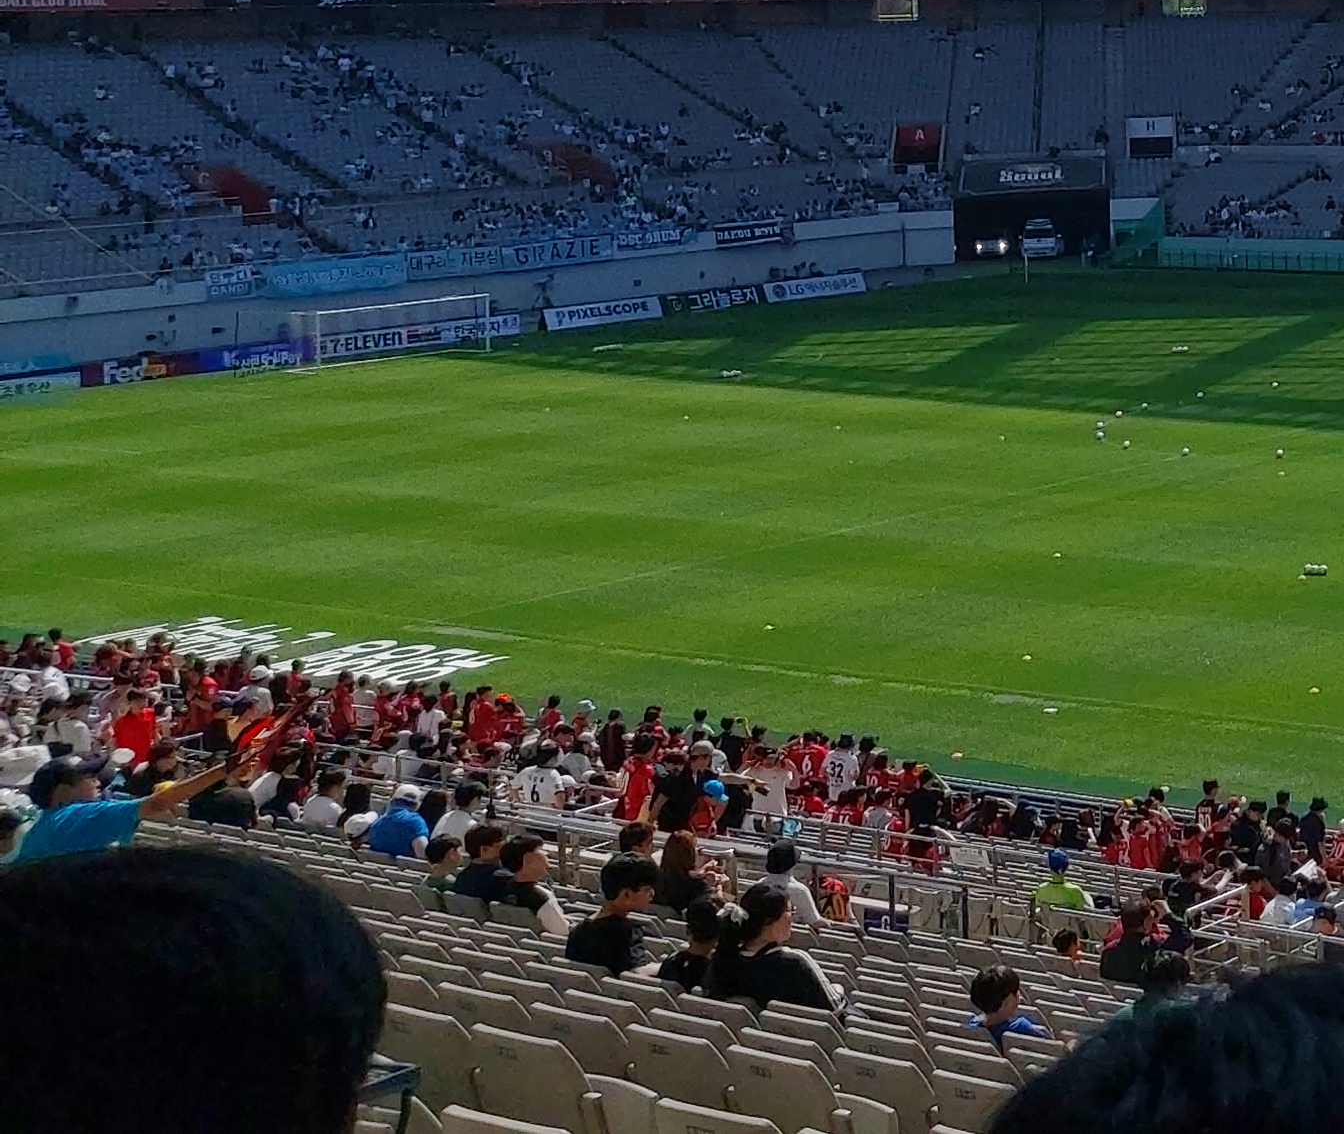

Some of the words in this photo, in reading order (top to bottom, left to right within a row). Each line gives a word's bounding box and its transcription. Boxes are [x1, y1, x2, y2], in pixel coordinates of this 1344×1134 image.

[1146, 120, 1155, 131] H
[915, 129, 925, 141] A
[460, 247, 499, 268] 자부심
[513, 238, 600, 264] GRAZIE
[568, 301, 649, 321] PIXELSCOPE
[802, 754, 812, 772] 6
[829, 760, 844, 779] 32
[531, 784, 539, 802] 6
